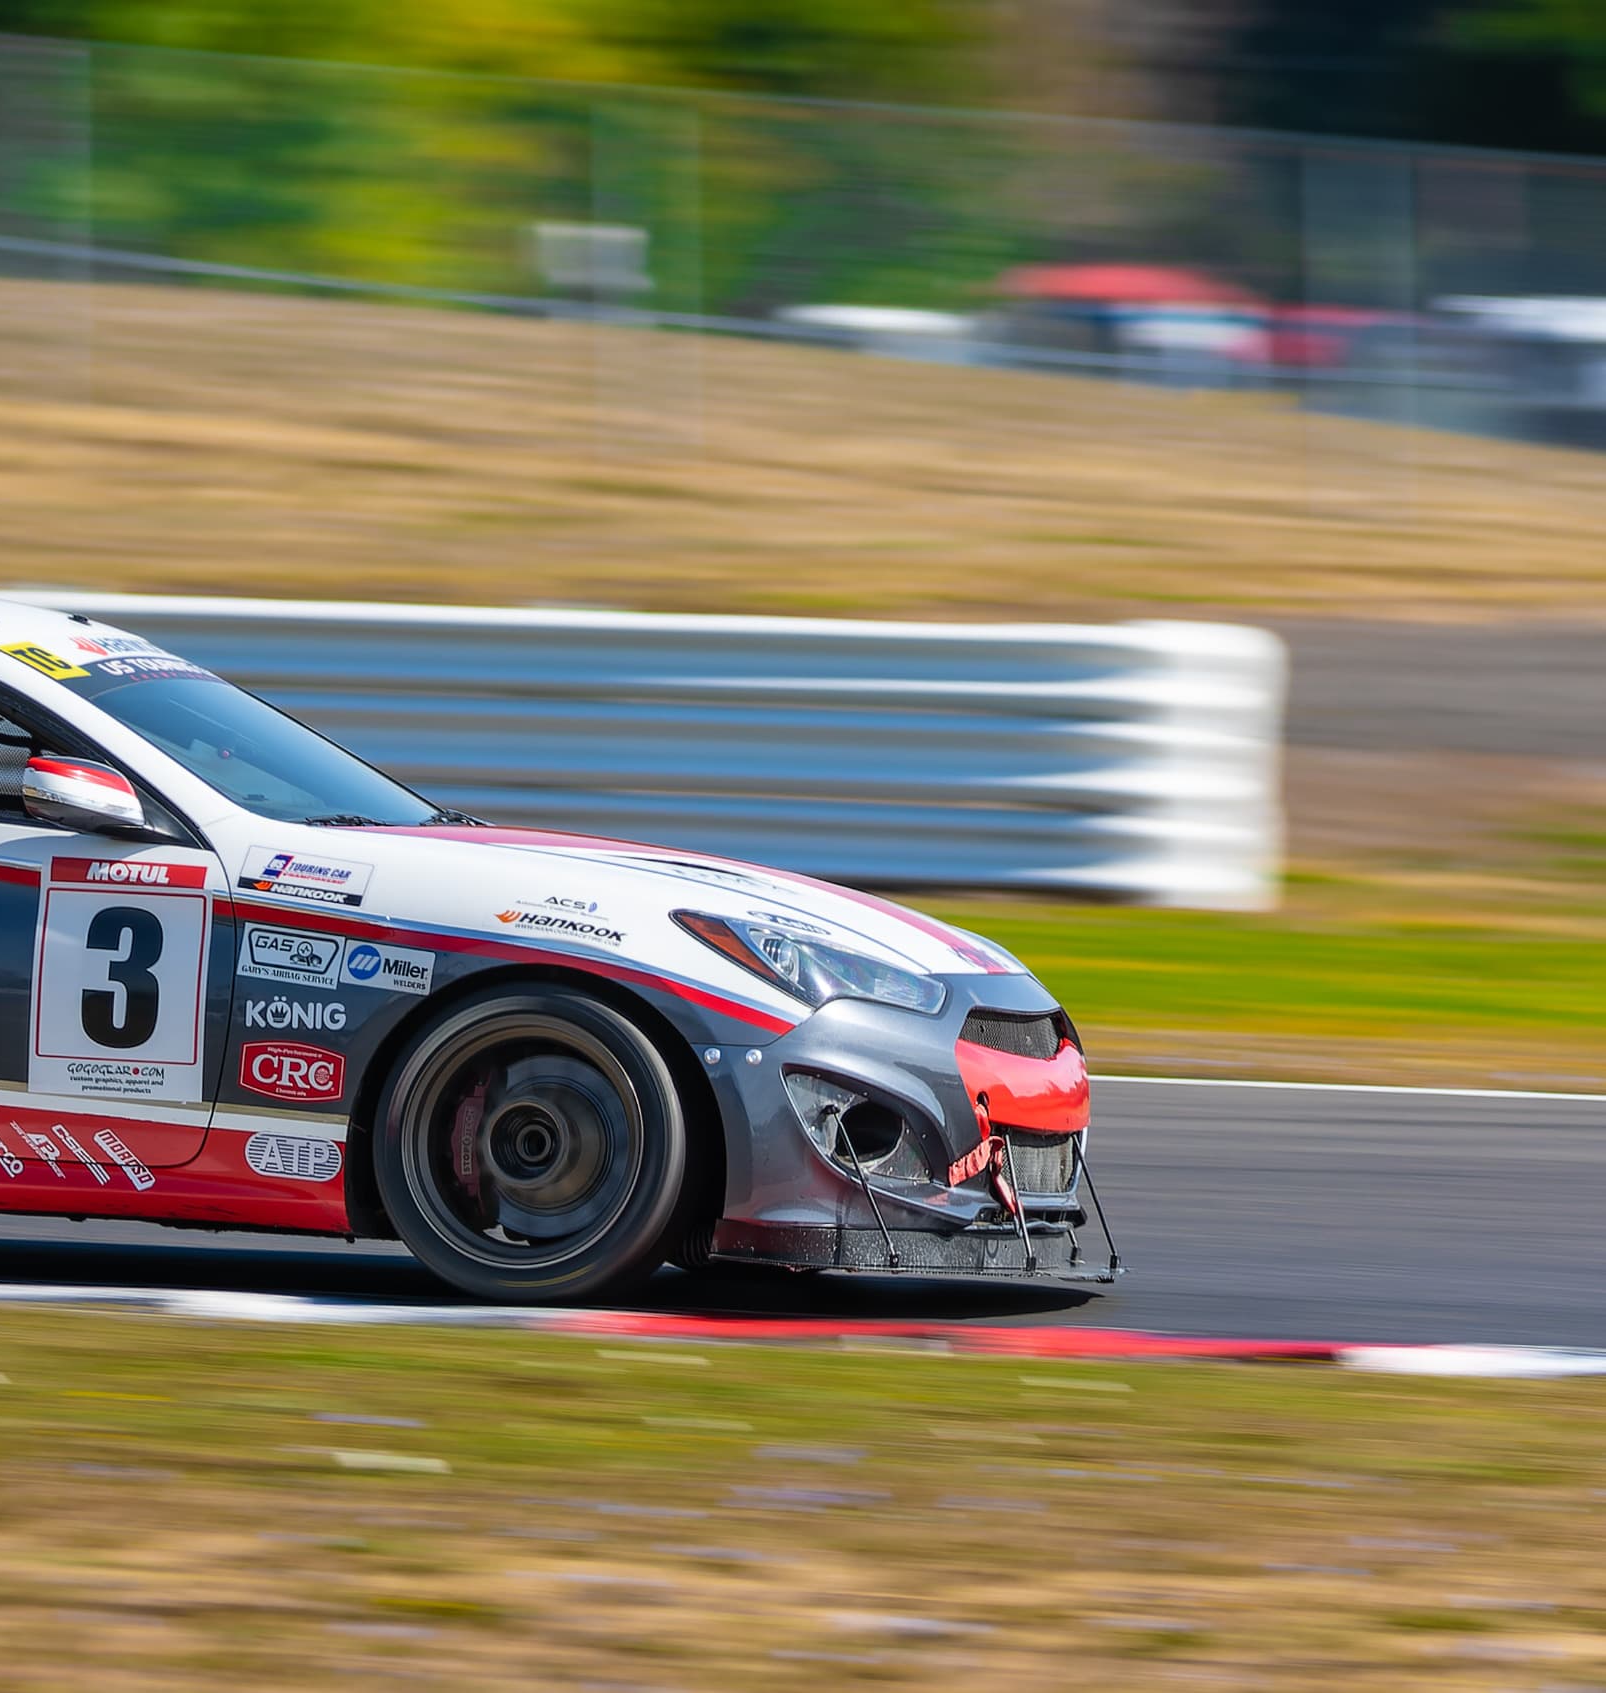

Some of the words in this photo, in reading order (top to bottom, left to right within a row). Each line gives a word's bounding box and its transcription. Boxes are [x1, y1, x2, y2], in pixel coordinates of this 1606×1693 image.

[9, 647, 72, 672] TC
[98, 660, 136, 676] US
[86, 862, 170, 884] MOTUL
[288, 862, 329, 877] TOURING
[330, 867, 352, 879] CAR
[544, 896, 586, 910] ACS
[255, 935, 295, 953] GAS
[81, 906, 164, 1049] 3
[241, 965, 270, 976] GARY'S
[272, 969, 301, 981] AIRBAG
[302, 974, 335, 986] SERVICE
[382, 957, 428, 980] Miller
[394, 979, 426, 990] WELDERS
[245, 996, 347, 1031] KÖNIG
[125, 1079, 150, 1087] apparel
[252, 1054, 334, 1091] CRC
[82, 1084, 122, 1092] promotional
[123, 1086, 152, 1094] products
[259, 1135, 331, 1176] ATP
